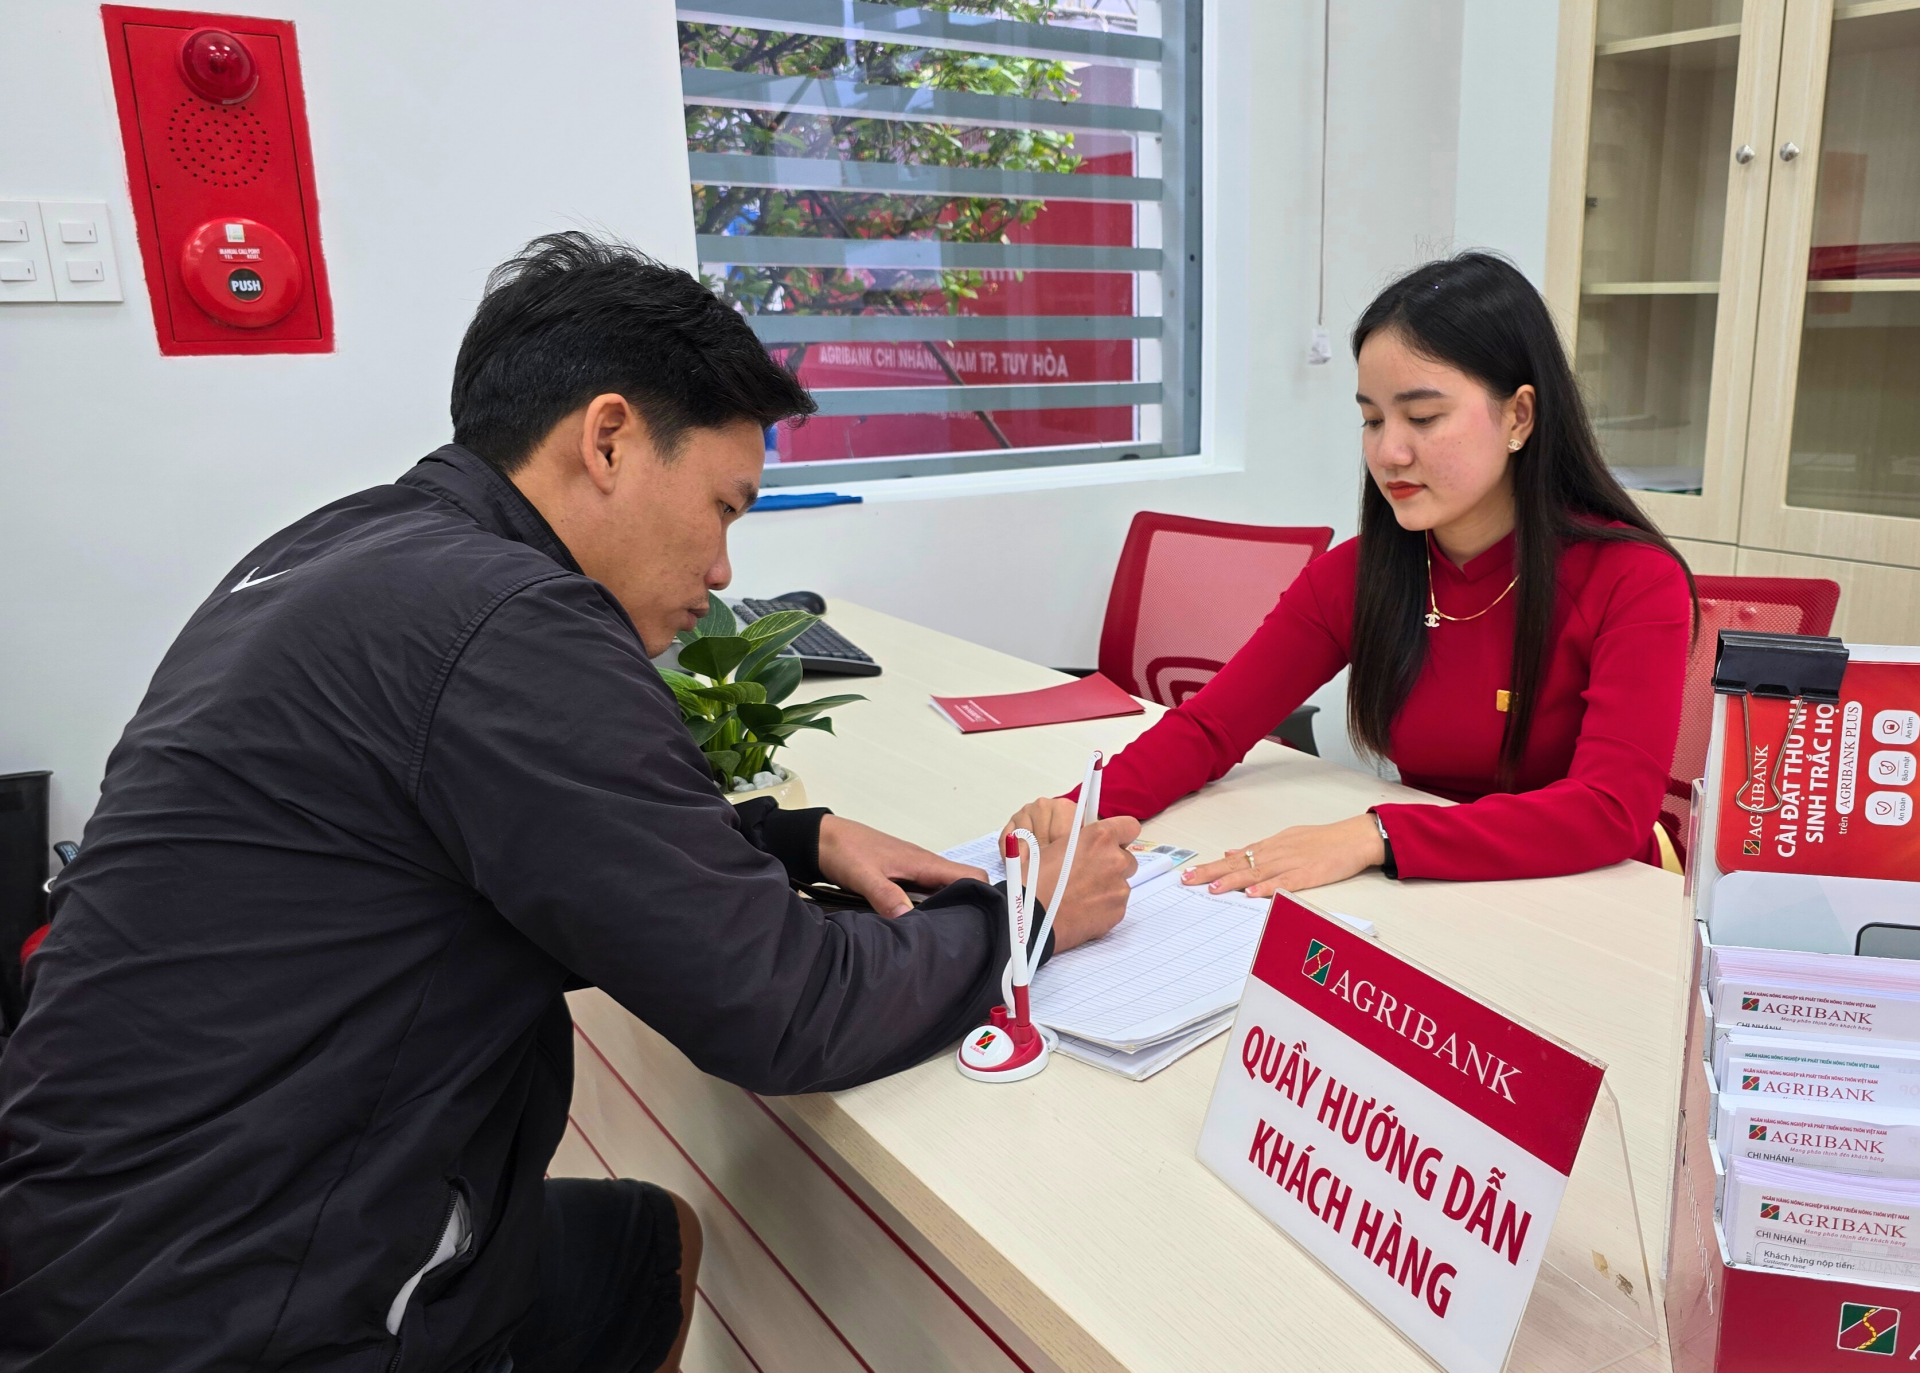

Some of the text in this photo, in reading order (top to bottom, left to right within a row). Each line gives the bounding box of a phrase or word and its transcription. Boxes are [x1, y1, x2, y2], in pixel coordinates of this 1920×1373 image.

[231, 280, 262, 292] PUSH
[819, 345, 872, 367] AGRIBANK
[875, 347, 897, 368] CHI
[979, 352, 998, 375] TP.
[1001, 353, 1028, 376] TUY
[1031, 346, 1069, 378] HÒA
[1788, 699, 1807, 729] NH
[1784, 735, 1805, 776] THU
[1839, 706, 1859, 809] AGRIBANK PLUS
[1806, 703, 1839, 843] SINH TRẮC HỌ
[1749, 744, 1768, 838] AGRIBANK
[1838, 816, 1849, 835] trên
[1774, 825, 1798, 858] CÀI
[1015, 895, 1025, 944] AGRIBANK
[1762, 1002, 1873, 1025] AGRIBANK
[1329, 969, 1523, 1105] AGRIBANK
[1763, 1081, 1876, 1102] AGRIBANK
[1242, 1025, 1533, 1267] QUẦY HƯỚNG DẪN
[1747, 1151, 1795, 1163] CHI NHÁNH
[1769, 1131, 1885, 1154] AGRIBANK
[1248, 1117, 1458, 1320] KHÁCH HÀNG
[1783, 1211, 1907, 1239] AGRIBANK
[1755, 1229, 1808, 1246] CHI NHÁNH
[1763, 1257, 1791, 1268] Customer
[1764, 1250, 1791, 1262] Khách
[1791, 1254, 1816, 1267] hàng
[1815, 1258, 1835, 1270] nộp
[1835, 1260, 1856, 1271] tiền:
